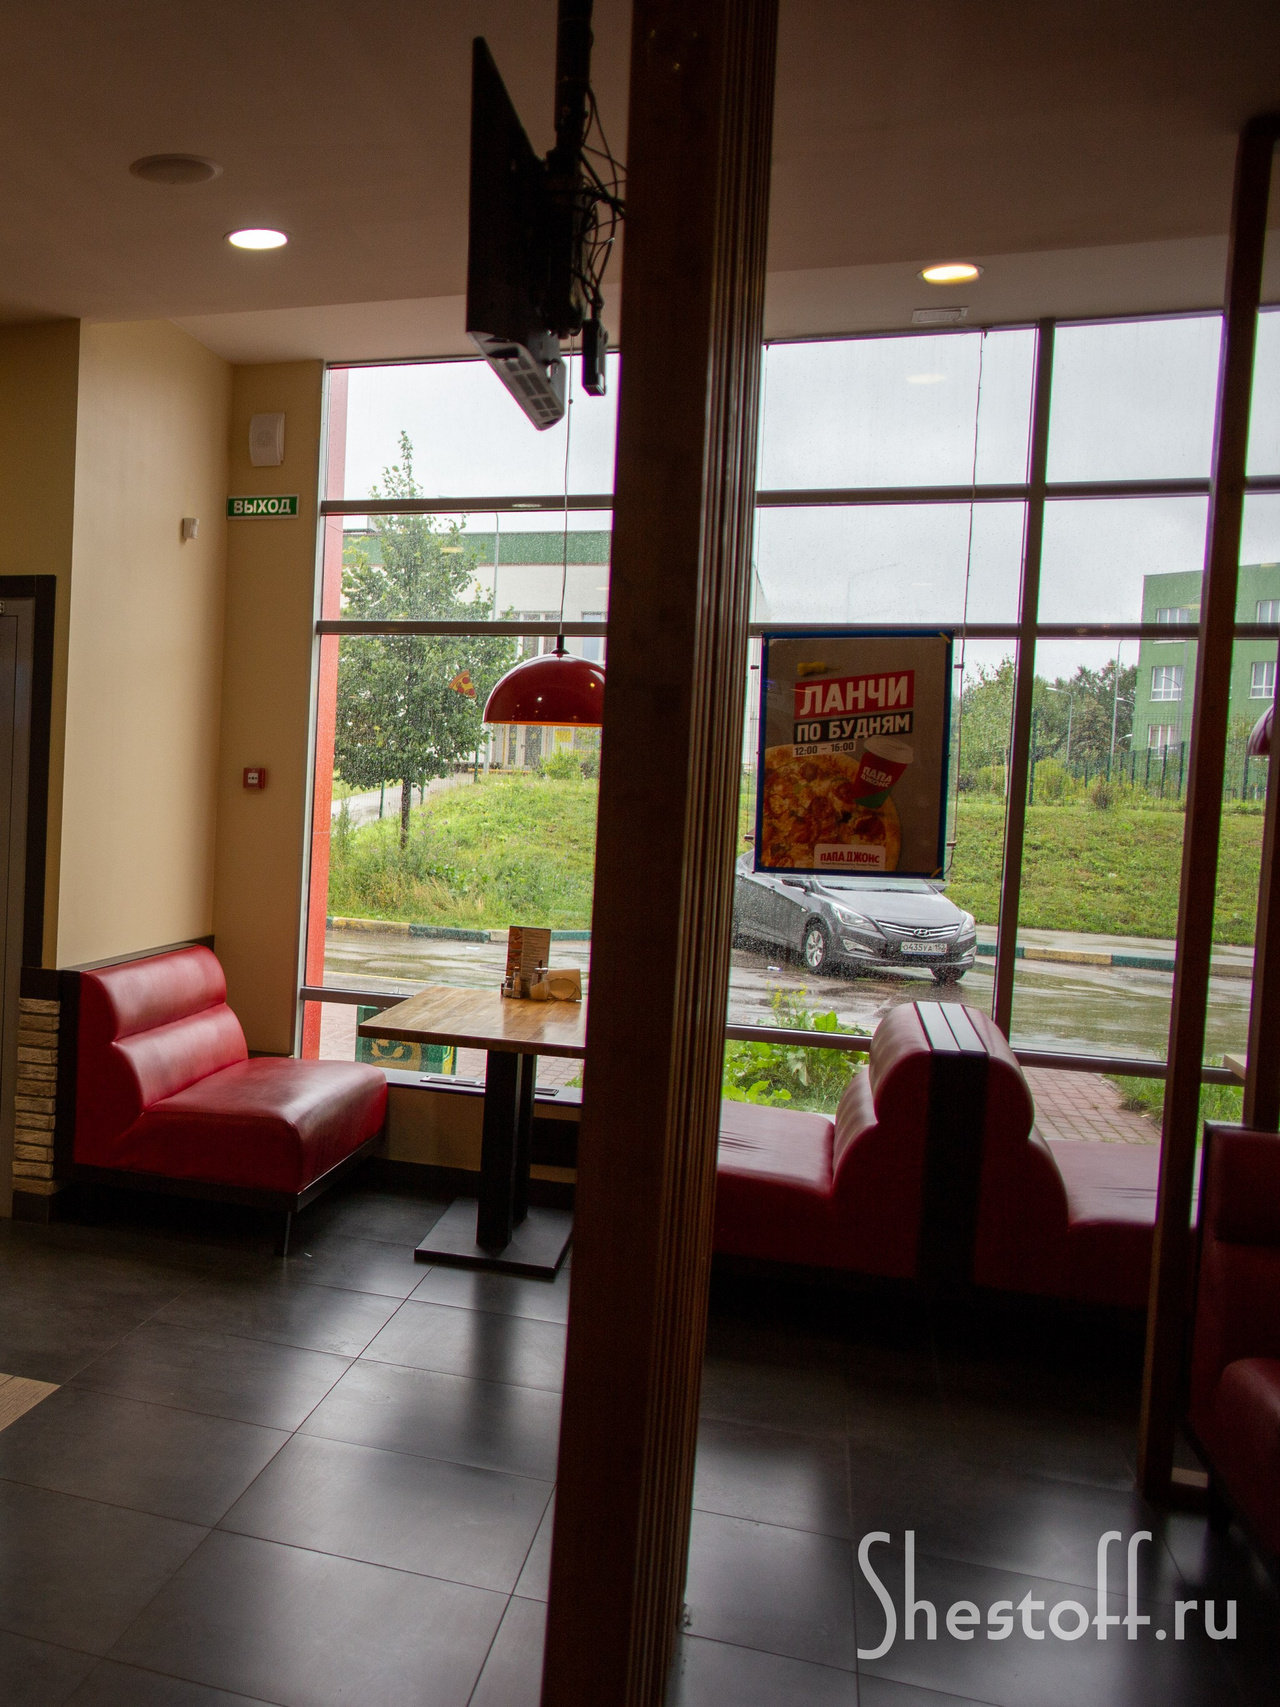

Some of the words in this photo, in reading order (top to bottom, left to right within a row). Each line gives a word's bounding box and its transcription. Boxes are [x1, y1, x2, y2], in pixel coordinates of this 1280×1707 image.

[233, 499, 291, 514] ВЫХОД
[799, 675, 909, 716] ЛАНЧИ
[797, 723, 821, 742] ПО
[828, 713, 910, 739] БУДНЯМ
[795, 745, 818, 756] 12:00
[831, 741, 854, 752] 16:00
[860, 773, 891, 788] ДЖОНС
[862, 766, 893, 783] ПАПА
[820, 851, 846, 863] ПАПА
[846, 851, 880, 864] ДЖОНС
